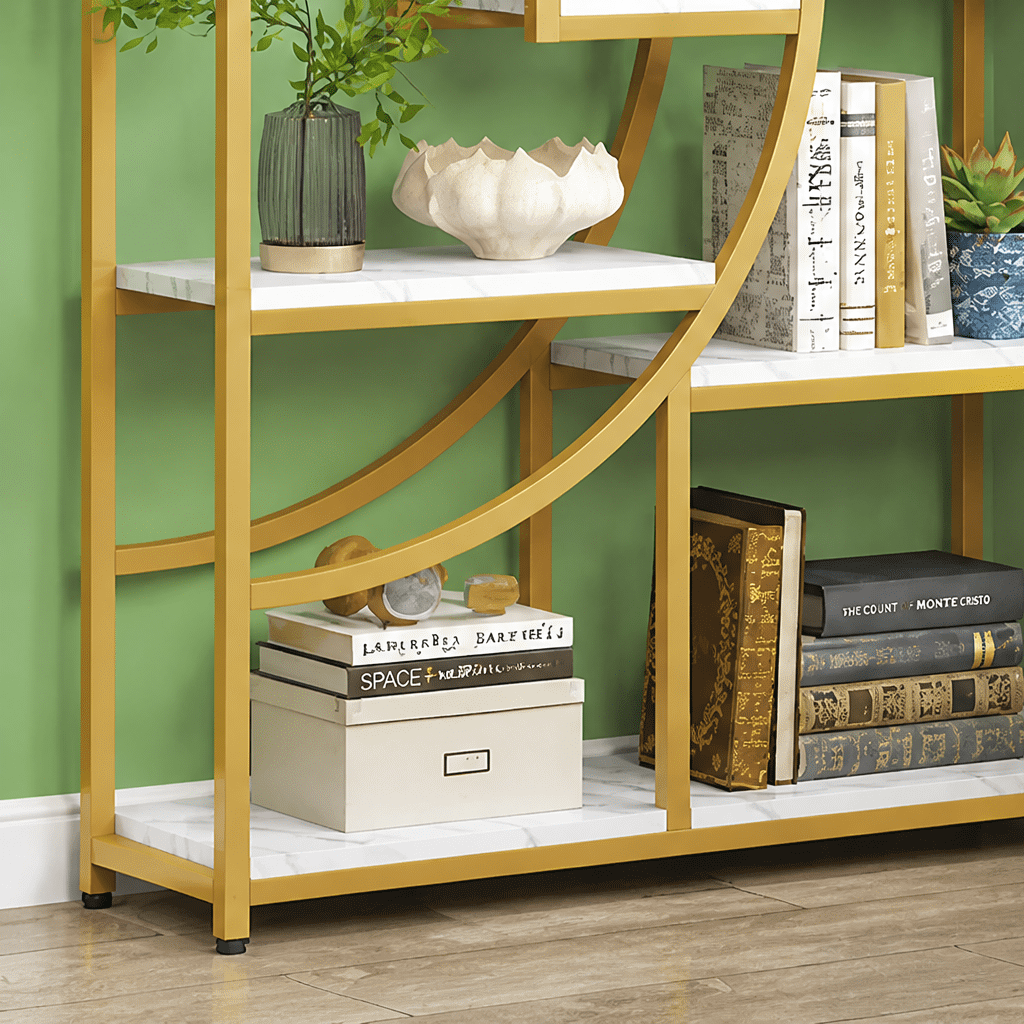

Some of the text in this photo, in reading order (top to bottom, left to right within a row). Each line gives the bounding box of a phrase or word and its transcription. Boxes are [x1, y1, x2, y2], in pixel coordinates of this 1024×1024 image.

[842, 605, 862, 617] THE
[862, 601, 899, 616] COUNT
[915, 596, 959, 611] MONTE
[360, 667, 423, 691] SPACE
